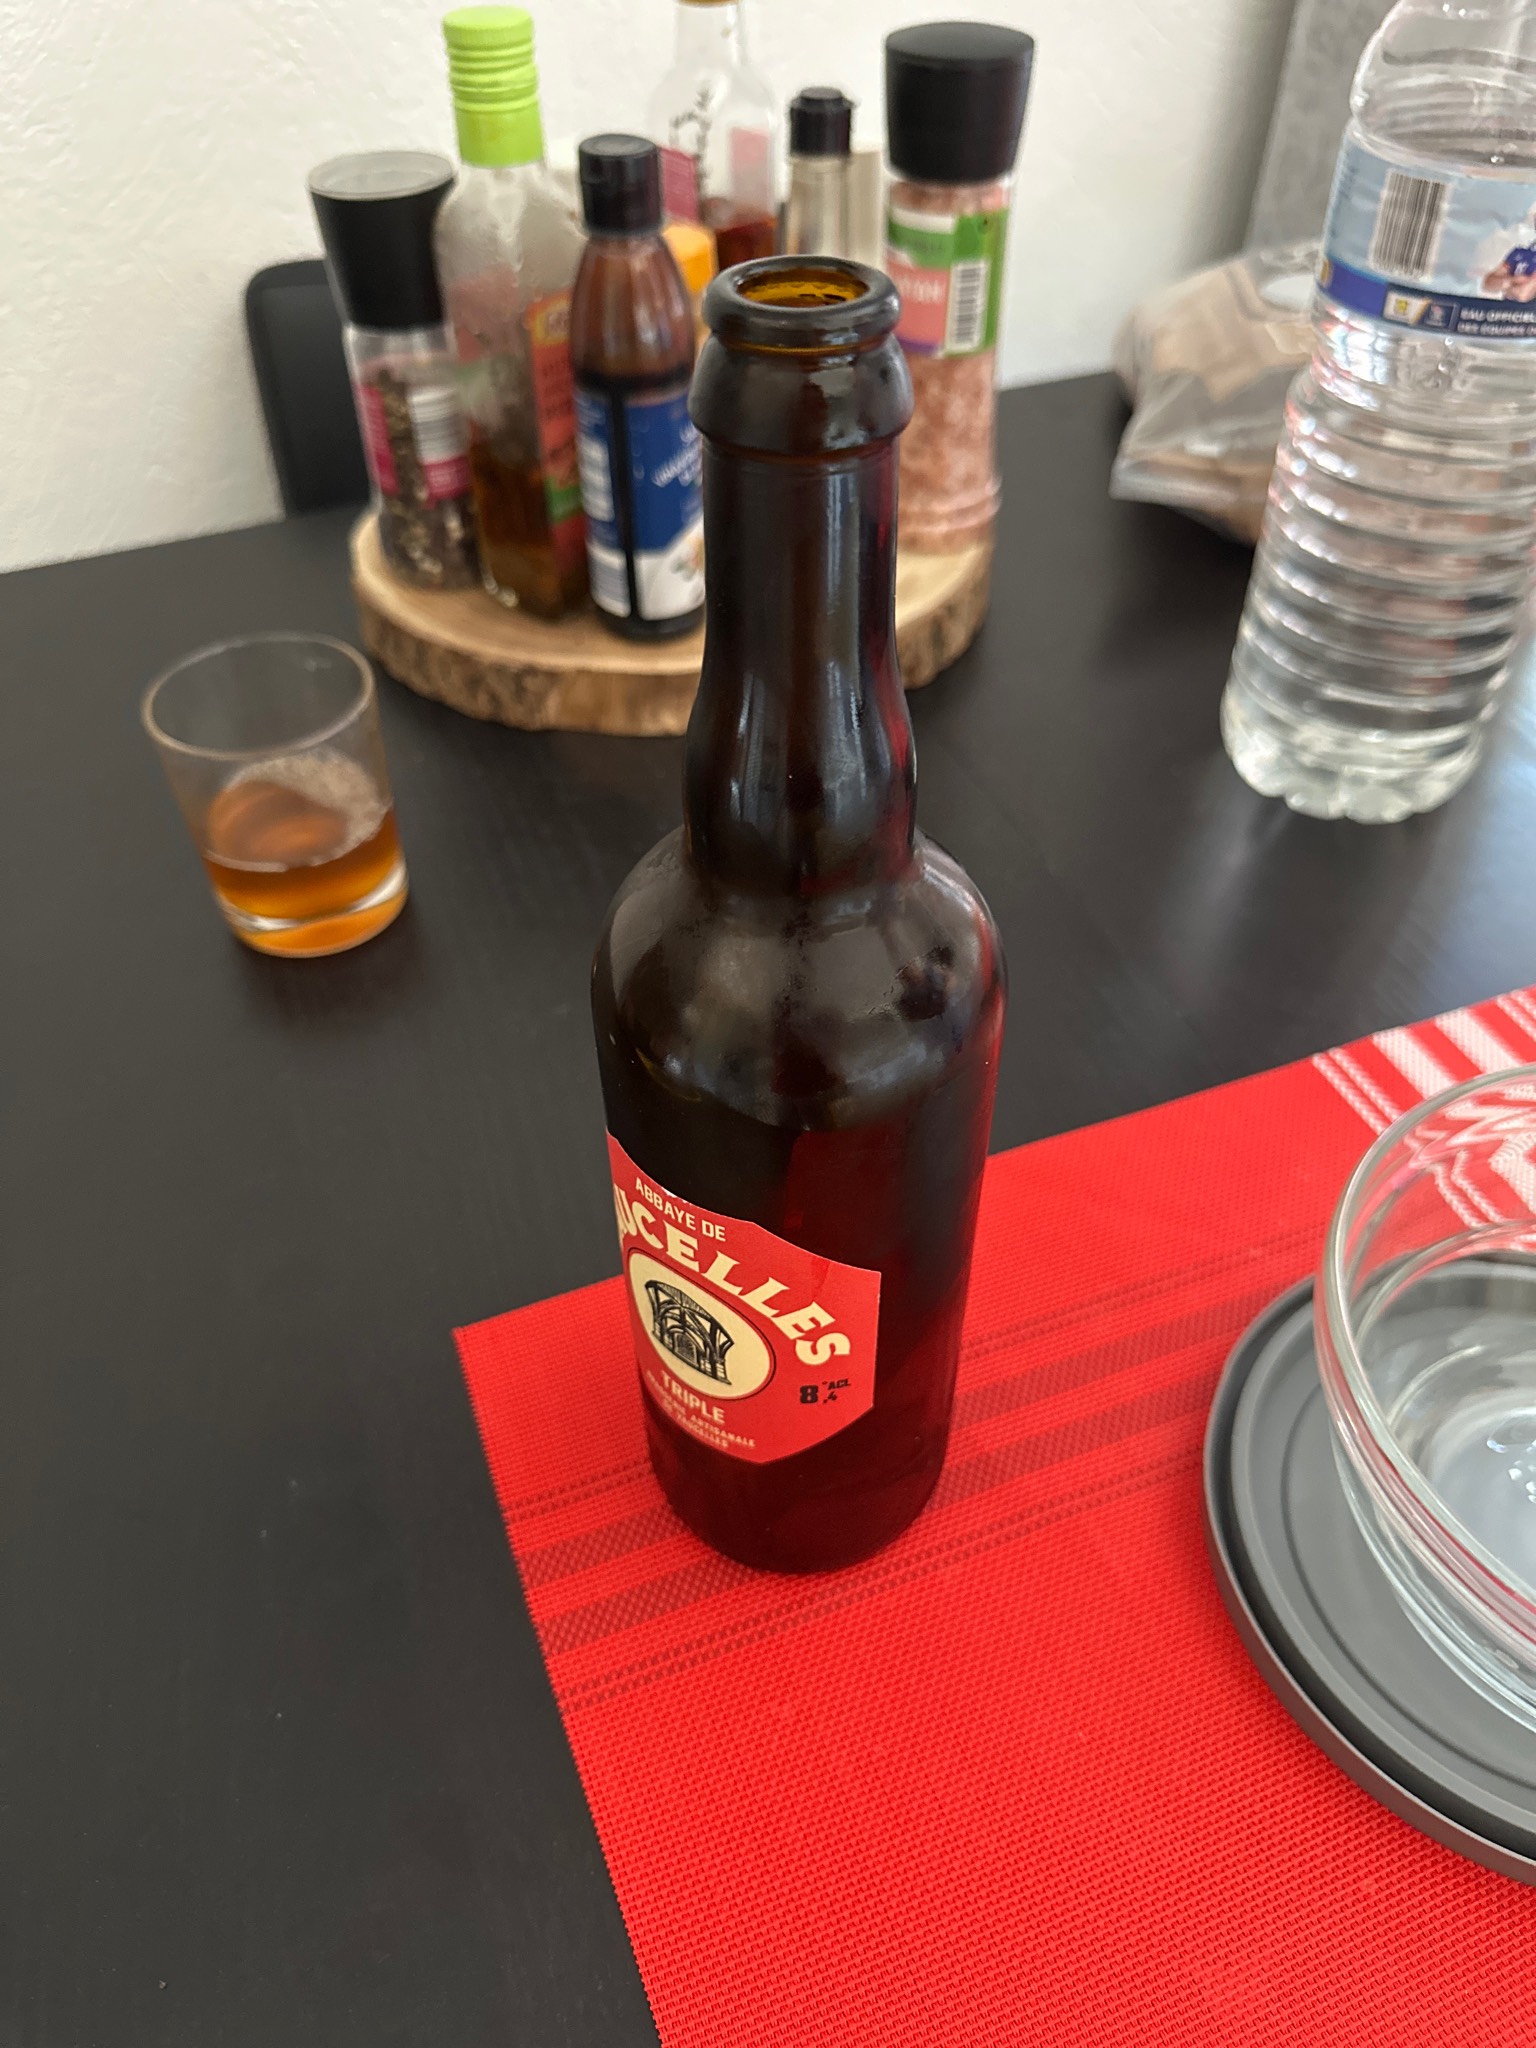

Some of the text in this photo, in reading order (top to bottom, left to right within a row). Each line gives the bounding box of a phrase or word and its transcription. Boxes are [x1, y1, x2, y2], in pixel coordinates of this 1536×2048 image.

[635, 1176, 726, 1242] ABBAYE DE
[661, 1370, 725, 1426] TRIPLE
[800, 1384, 819, 1404] 8
